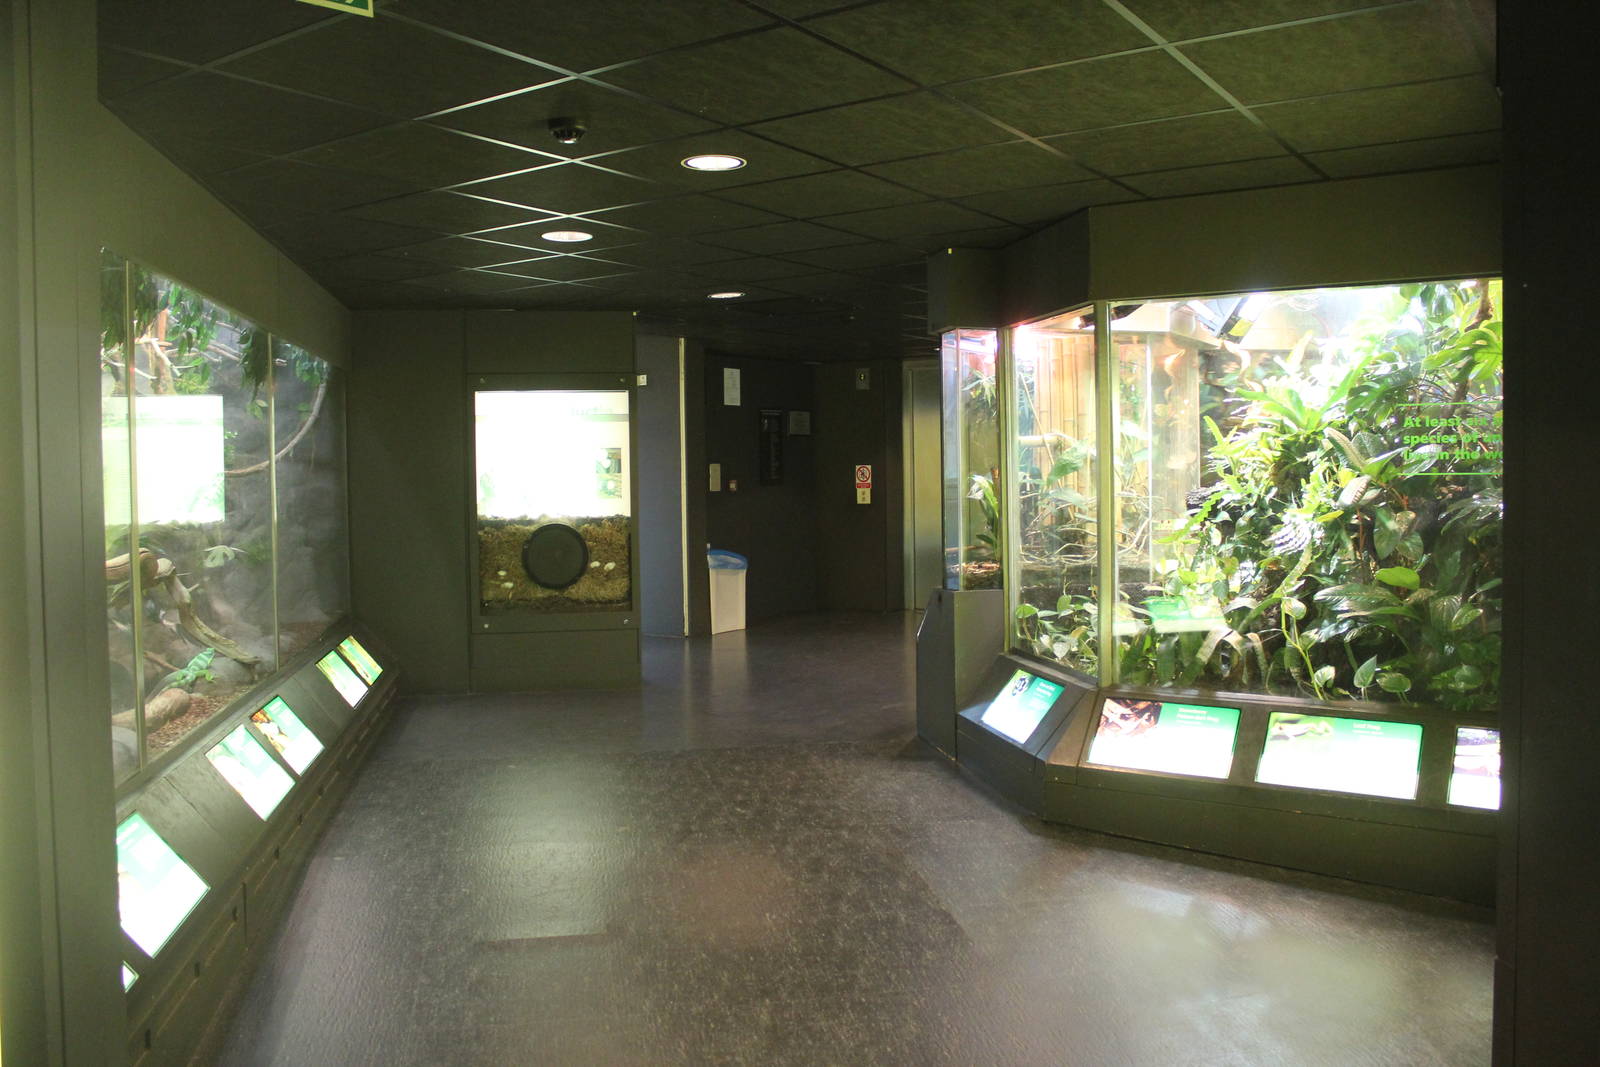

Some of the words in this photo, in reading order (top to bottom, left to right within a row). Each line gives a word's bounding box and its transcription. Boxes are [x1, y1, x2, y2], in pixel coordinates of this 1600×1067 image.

[1403, 416, 1421, 427] At
[1425, 415, 1461, 427] least
[1403, 432, 1456, 446] species
[1463, 431, 1479, 442] of
[1455, 448, 1480, 459] the
